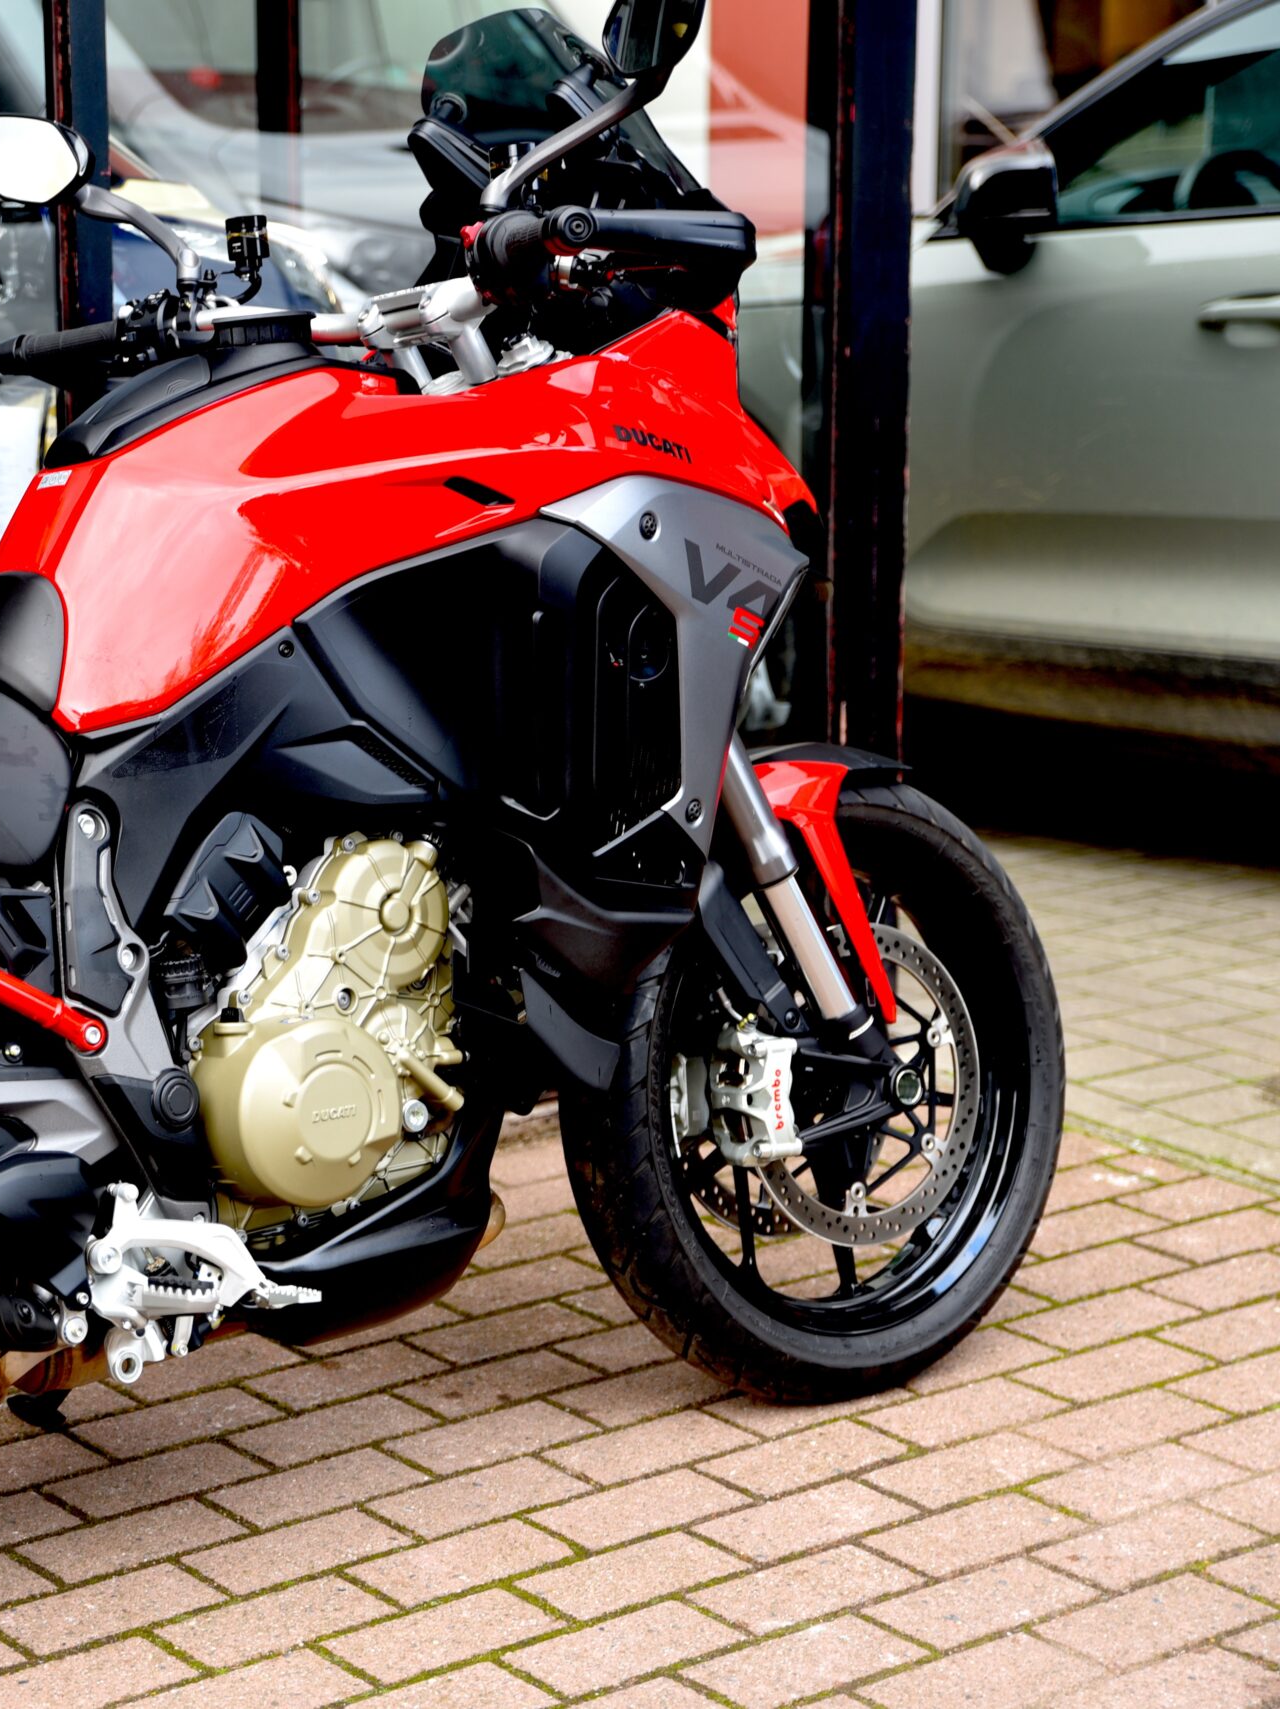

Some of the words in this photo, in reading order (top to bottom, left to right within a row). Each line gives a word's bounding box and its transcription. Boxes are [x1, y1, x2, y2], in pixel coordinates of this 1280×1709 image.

[613, 424, 693, 464] DUCATI
[684, 538, 782, 620] V4
[715, 542, 782, 587] MULTISTRADA
[728, 606, 765, 650] S
[312, 1104, 357, 1124] DUCATI
[771, 1068, 785, 1131] brembo
